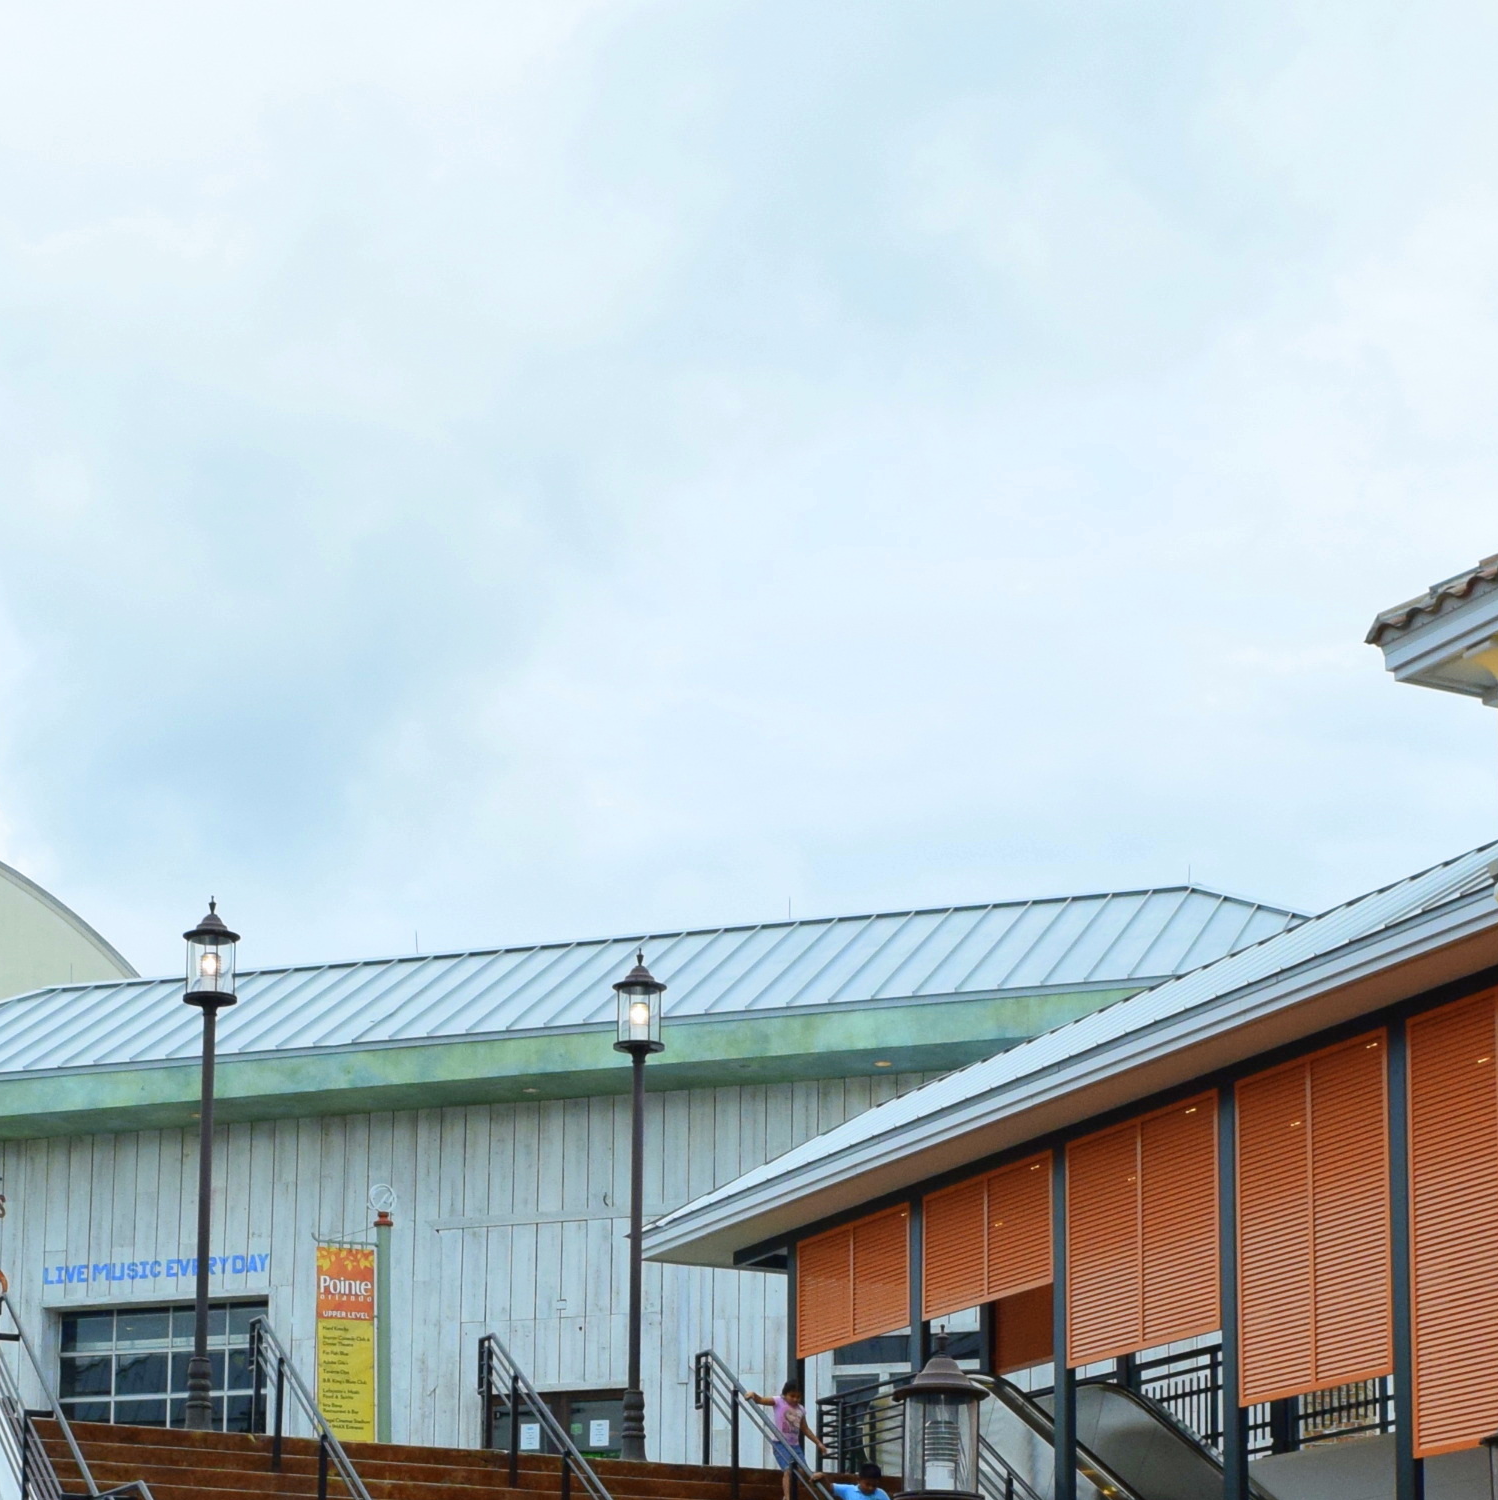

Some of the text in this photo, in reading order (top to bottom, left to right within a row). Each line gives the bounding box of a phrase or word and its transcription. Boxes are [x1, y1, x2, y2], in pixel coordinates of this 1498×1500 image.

[43, 1265, 88, 1285] LIVE
[92, 1260, 161, 1282] MUSIC
[320, 1275, 372, 1296] Pointe
[320, 1293, 372, 1302] orlando
[323, 1310, 346, 1318] UPPER
